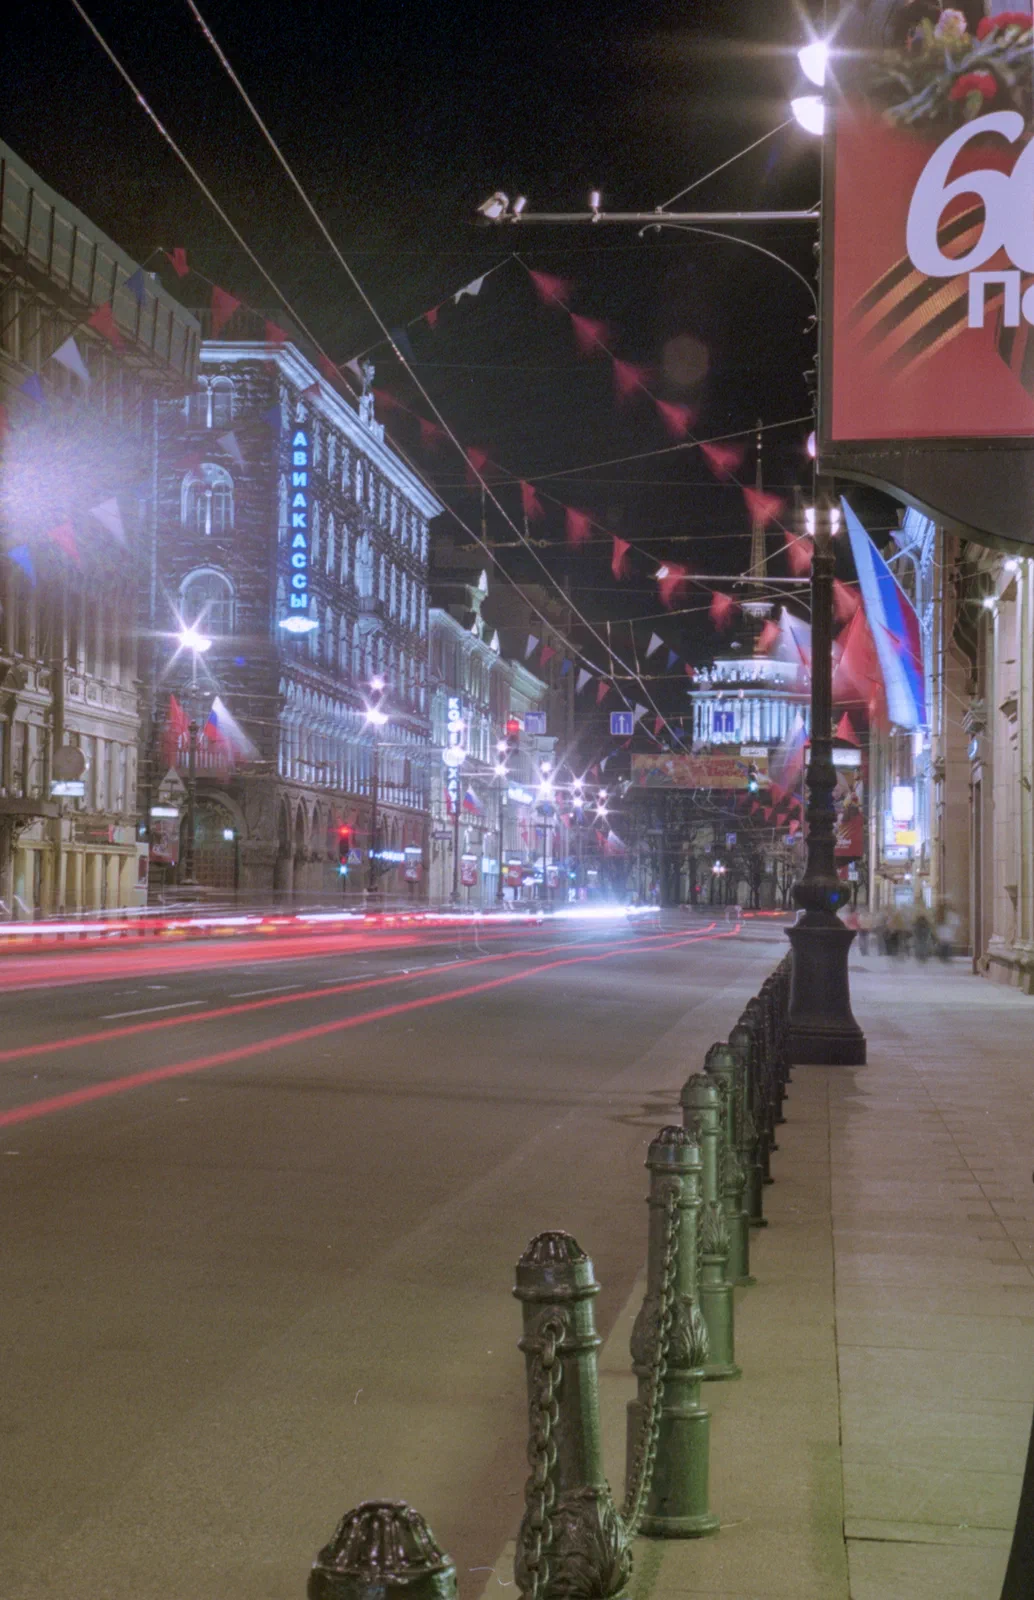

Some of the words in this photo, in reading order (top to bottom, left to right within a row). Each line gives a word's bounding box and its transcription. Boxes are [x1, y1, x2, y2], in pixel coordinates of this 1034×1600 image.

[906, 110, 1034, 277] 6
[968, 271, 1034, 328] П
[290, 431, 308, 608] АВИАКАССЫ
